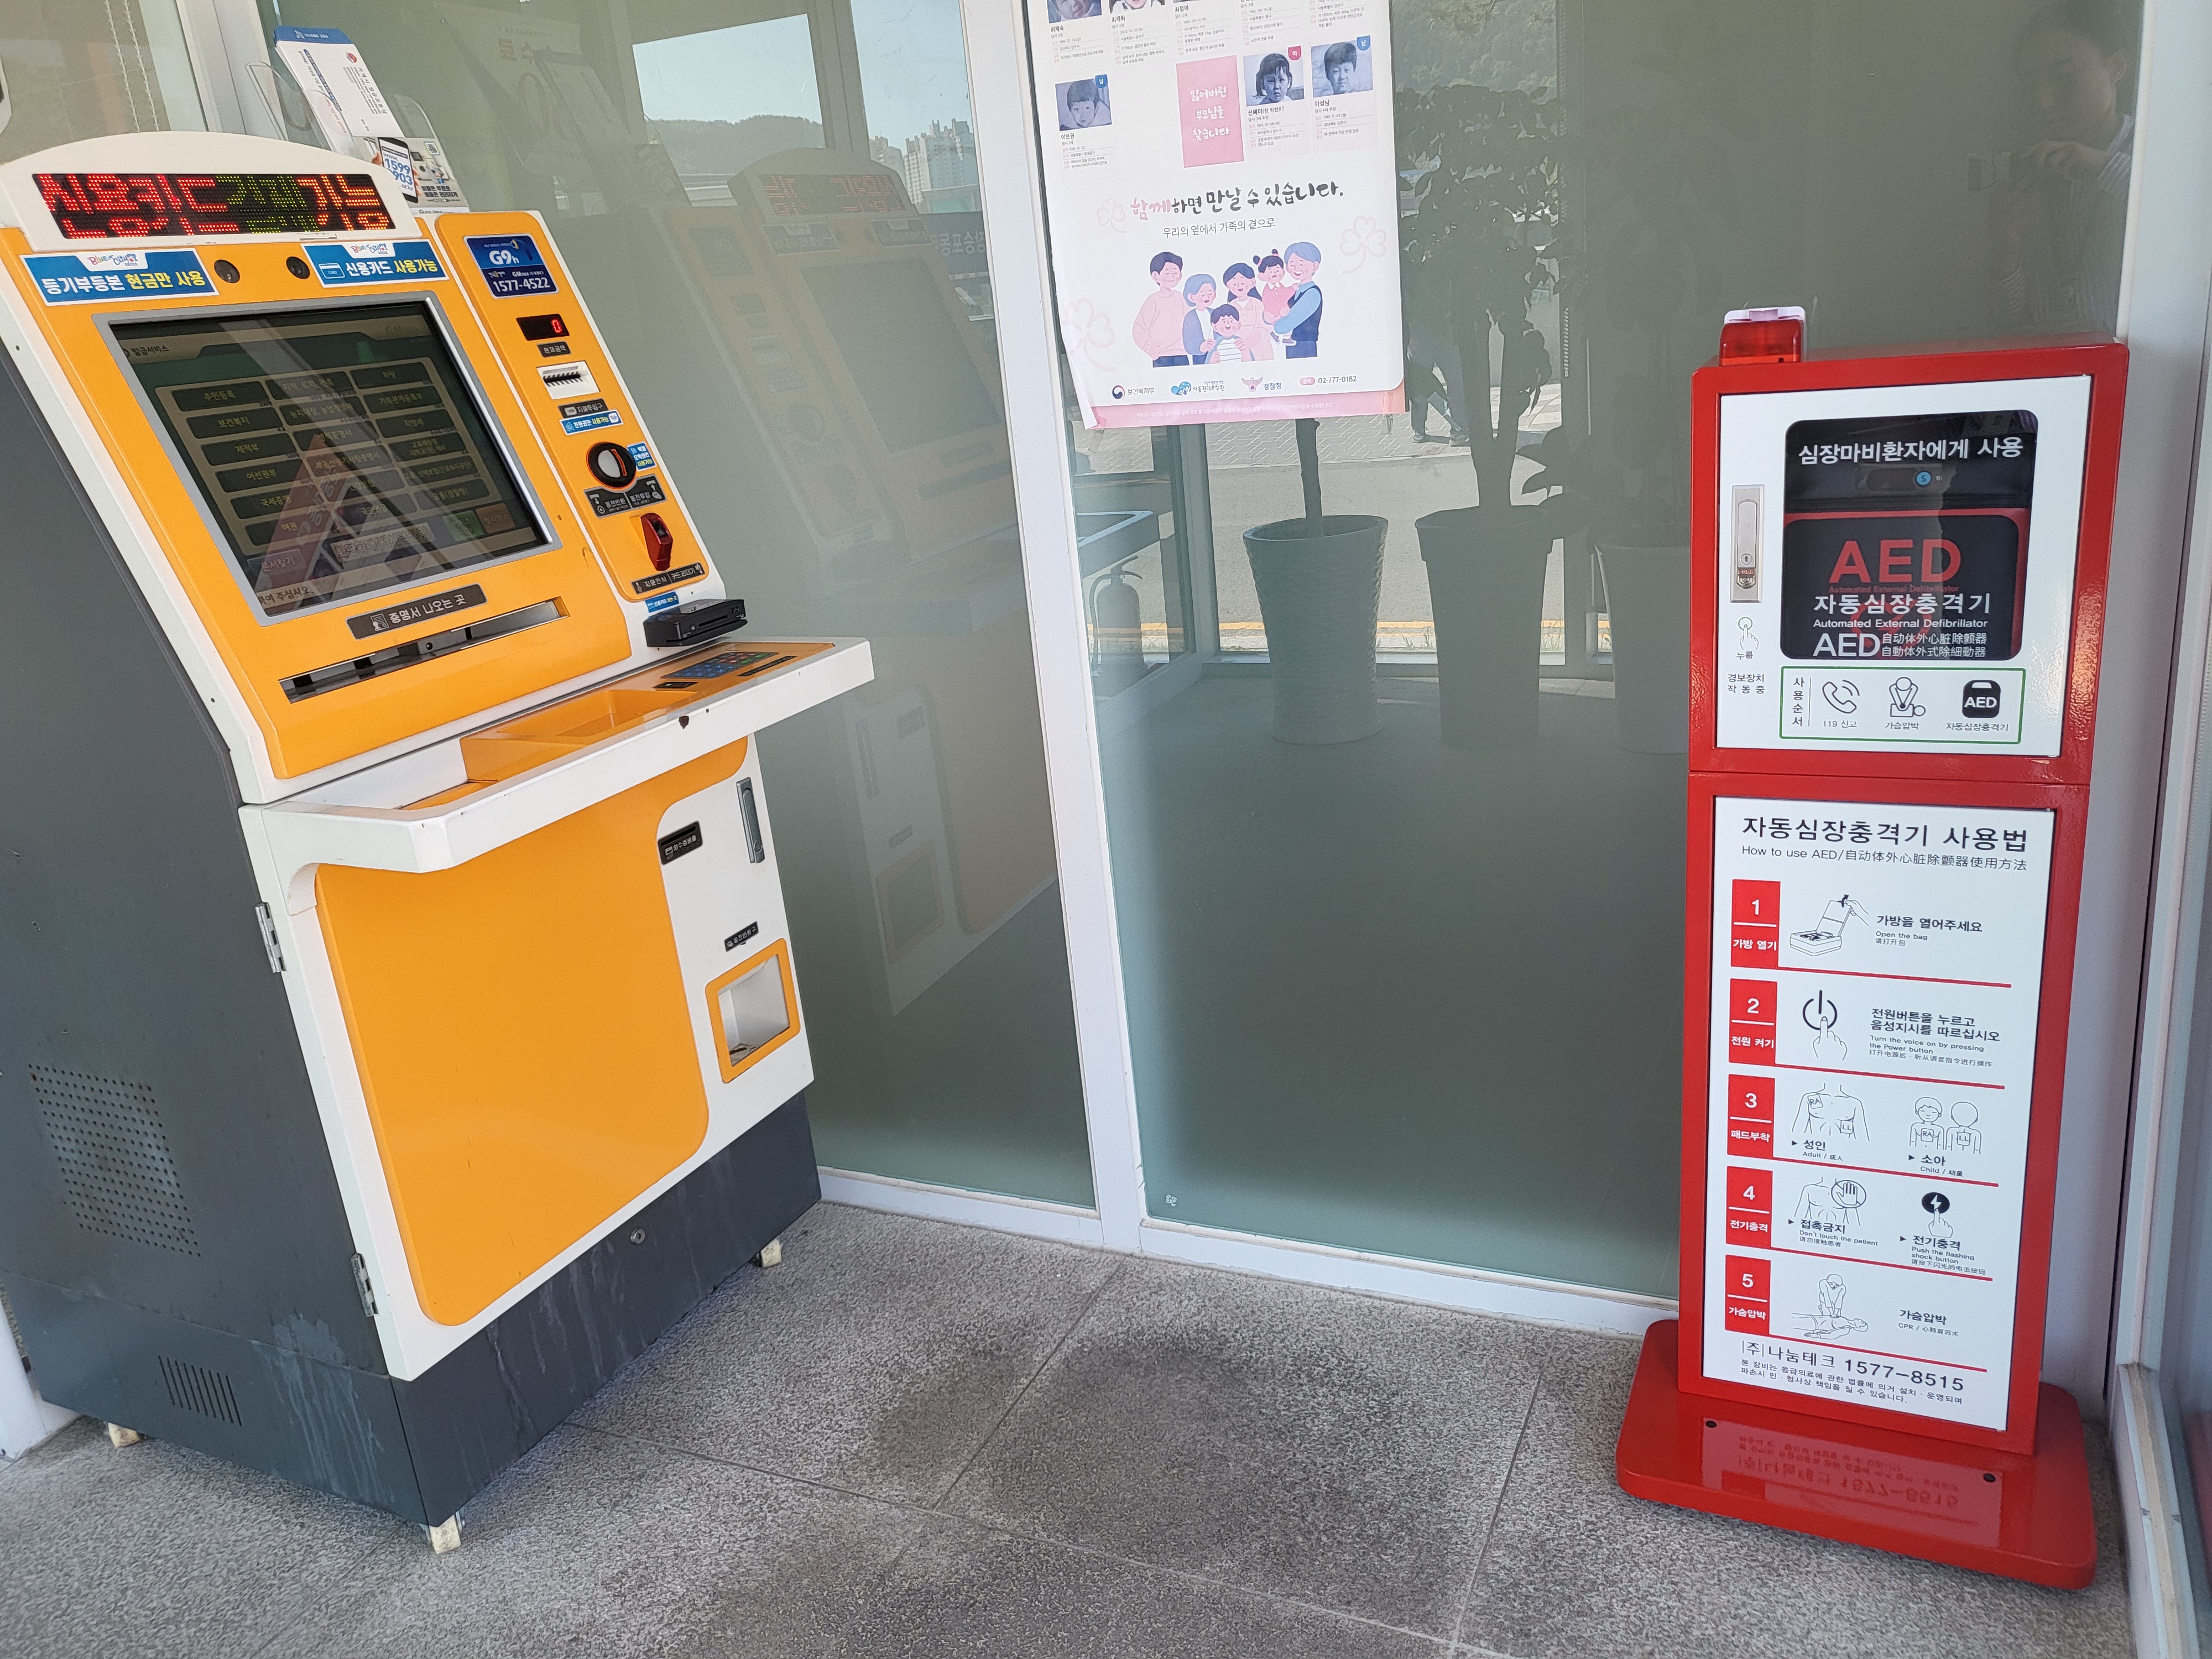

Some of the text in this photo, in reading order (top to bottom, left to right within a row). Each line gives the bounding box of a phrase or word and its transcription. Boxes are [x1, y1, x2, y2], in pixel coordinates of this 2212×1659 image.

[1190, 85, 1227, 102] 잃어버린
[1314, 99, 1330, 107] 이성남
[1196, 105, 1224, 121] 부모님을
[1192, 126, 1230, 142] 찾습니다
[385, 158, 410, 174] 1599
[1130, 181, 1344, 221] 함께하면 만날 수 있습니다.
[1163, 217, 1276, 238] 우리의 옆에서 가족의 곁으로
[346, 259, 438, 276] 신용카드 사용가능
[41, 270, 206, 295] 등기부등본 현금만 사용
[493, 277, 551, 293] 1577-4522
[551, 319, 562, 333] 0
[131, 345, 170, 356] 발급서비스
[1317, 375, 1357, 384] 02-777-0182
[1128, 387, 1155, 396] 보건복지부
[218, 416, 251, 428] 보건복지
[235, 442, 260, 453] 제적부
[1798, 436, 2023, 465] 심장마비환자에게 사용
[246, 468, 278, 481] 어선원부
[260, 495, 292, 507] 국세증명
[281, 521, 299, 531] 여권
[260, 555, 295, 572] 문서찾기
[1828, 539, 1961, 583] AED
[643, 568, 696, 588] 지문인식 카드리더기
[276, 586, 314, 601] 주십시오.
[389, 594, 467, 624] 증명서 나오는 곳
[1813, 593, 1990, 614] 자동심장충격기
[1813, 619, 1988, 628] Automated External Defibrillator
[1812, 633, 1880, 657] AED
[1882, 633, 1987, 644] 自动体外心脏除颤器
[1736, 651, 1753, 660] 누름
[1882, 646, 1986, 658] 自動体外式除細動器
[1728, 674, 1764, 682] 경보장치
[1964, 696, 1997, 708] AED
[1885, 721, 1919, 730] 가슴압박
[1945, 722, 2008, 732] 자동심장충격기
[1742, 816, 2027, 852] 자동심장충격기 사용법
[1742, 846, 1766, 855] How
[1771, 848, 1782, 857] to
[1752, 899, 1760, 915] 1
[1877, 915, 1983, 932] 가방을 열어주세요
[1733, 939, 1777, 951] 가방 열기
[1747, 998, 1760, 1014] 2
[1872, 1008, 1975, 1027] 전원버튼을 누르고
[1871, 1020, 2000, 1042] 음성지시를 따르십시오
[1731, 1036, 1774, 1048] 전원 켜기
[1745, 1093, 1757, 1108] 3
[1731, 1130, 1770, 1142] 패드부착
[1803, 1140, 1825, 1151] 성인
[1921, 1155, 1945, 1166] 소아
[1743, 1186, 1755, 1200] 4
[1730, 1219, 1768, 1233] 전기충격
[1801, 1219, 1845, 1234] 접촉금지
[1913, 1235, 1960, 1251] 전기충격
[1936, 1256, 1958, 1264] button
[1946, 1251, 1975, 1261] flashing
[1742, 1273, 1754, 1288] 5
[1729, 1307, 1766, 1320] 가슴압박
[1900, 1310, 1947, 1325] 가슴압박
[1845, 1359, 1963, 1391] 1577-8515
[1741, 1368, 1765, 1378] 파손시
[1787, 1375, 1811, 1385] 형사상
[1816, 1380, 1840, 1391] 책임을
[1870, 1390, 1907, 1404] 있습니다.
[1753, 1361, 1777, 1371] 장비는
[1781, 1366, 1822, 1380] 응급의료에
[1827, 1374, 1844, 1384] 관한
[1848, 1378, 1874, 1389] 법률에
[1878, 1384, 1895, 1392] 의거
[1900, 1387, 1916, 1396] 설치
[1927, 1392, 1962, 1405] 운영되며
